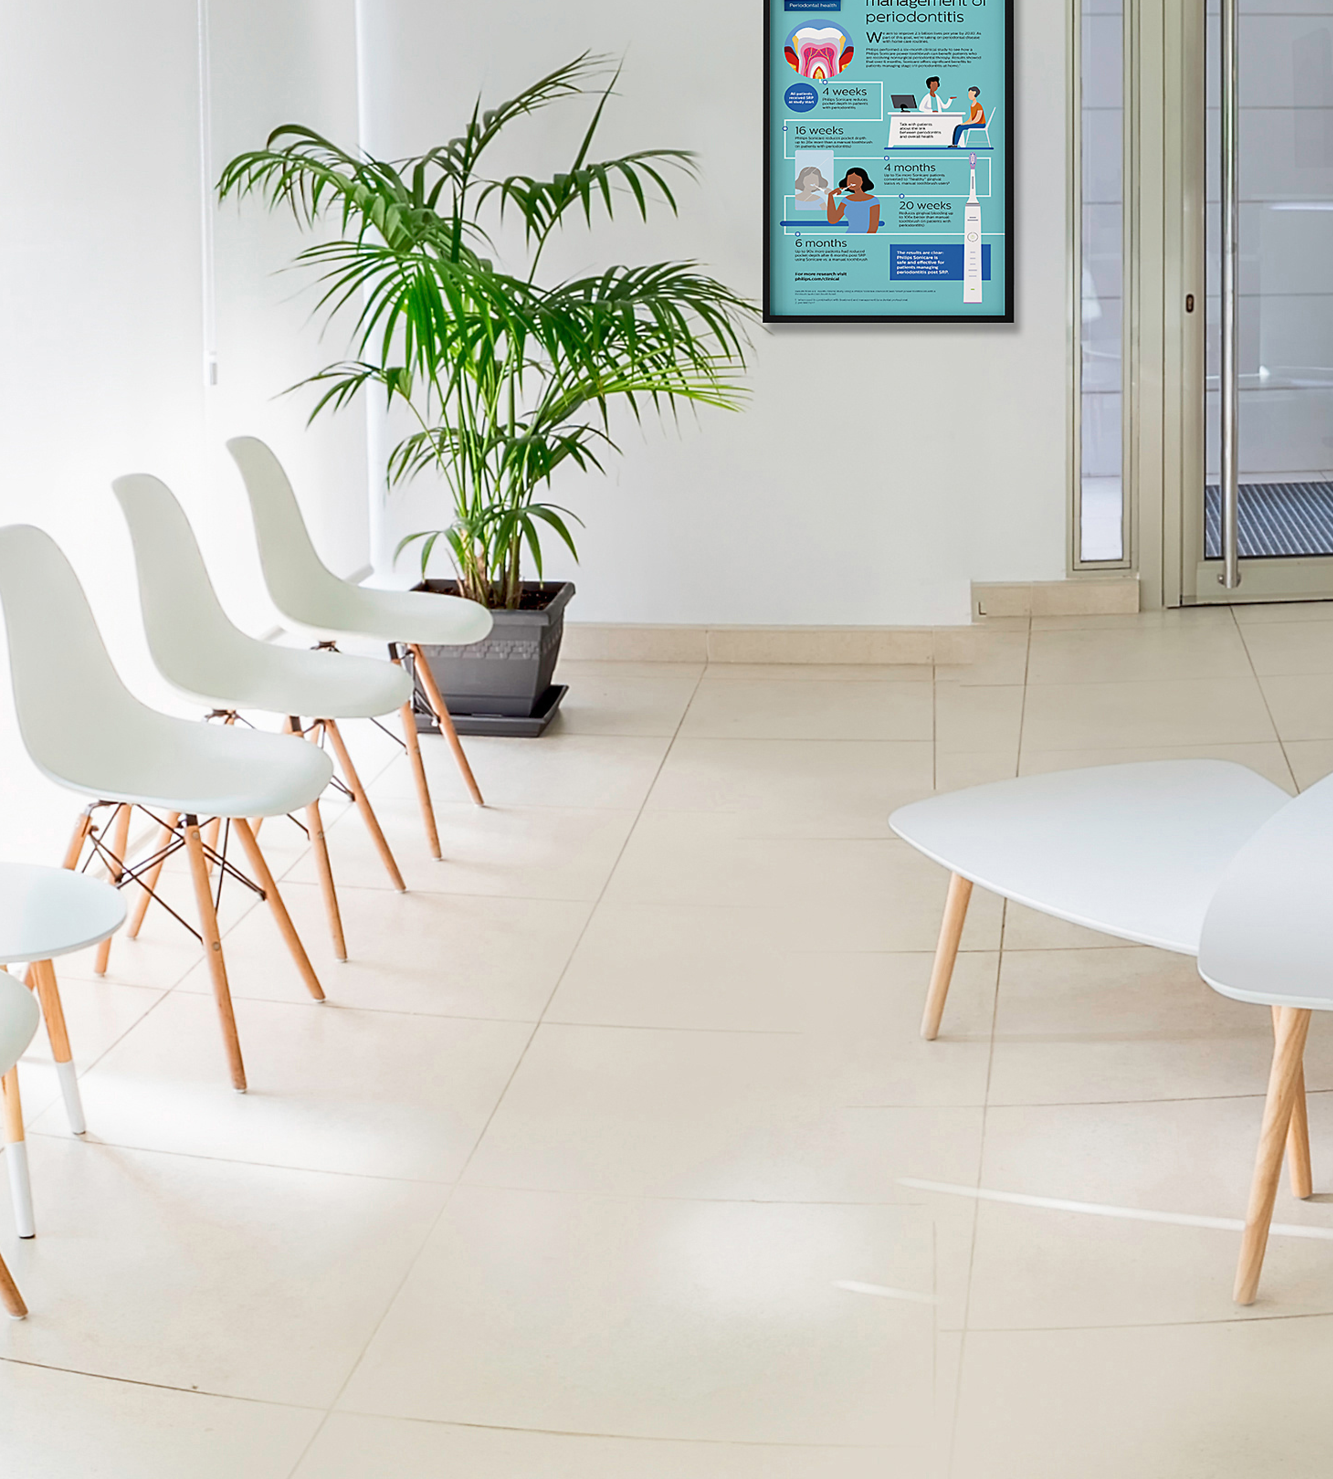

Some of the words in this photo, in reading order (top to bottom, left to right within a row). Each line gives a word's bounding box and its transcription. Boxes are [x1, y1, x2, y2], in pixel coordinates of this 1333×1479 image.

[866, 11, 964, 25] periodontitis
[822, 87, 829, 96] 4
[832, 87, 867, 96] weeks
[795, 126, 807, 135] 16
[809, 126, 844, 135] weeks
[884, 163, 890, 171] 4
[894, 163, 936, 172] months
[899, 201, 914, 210] 20
[917, 201, 952, 210] weeks
[795, 239, 802, 247] 6
[805, 239, 847, 247] months
